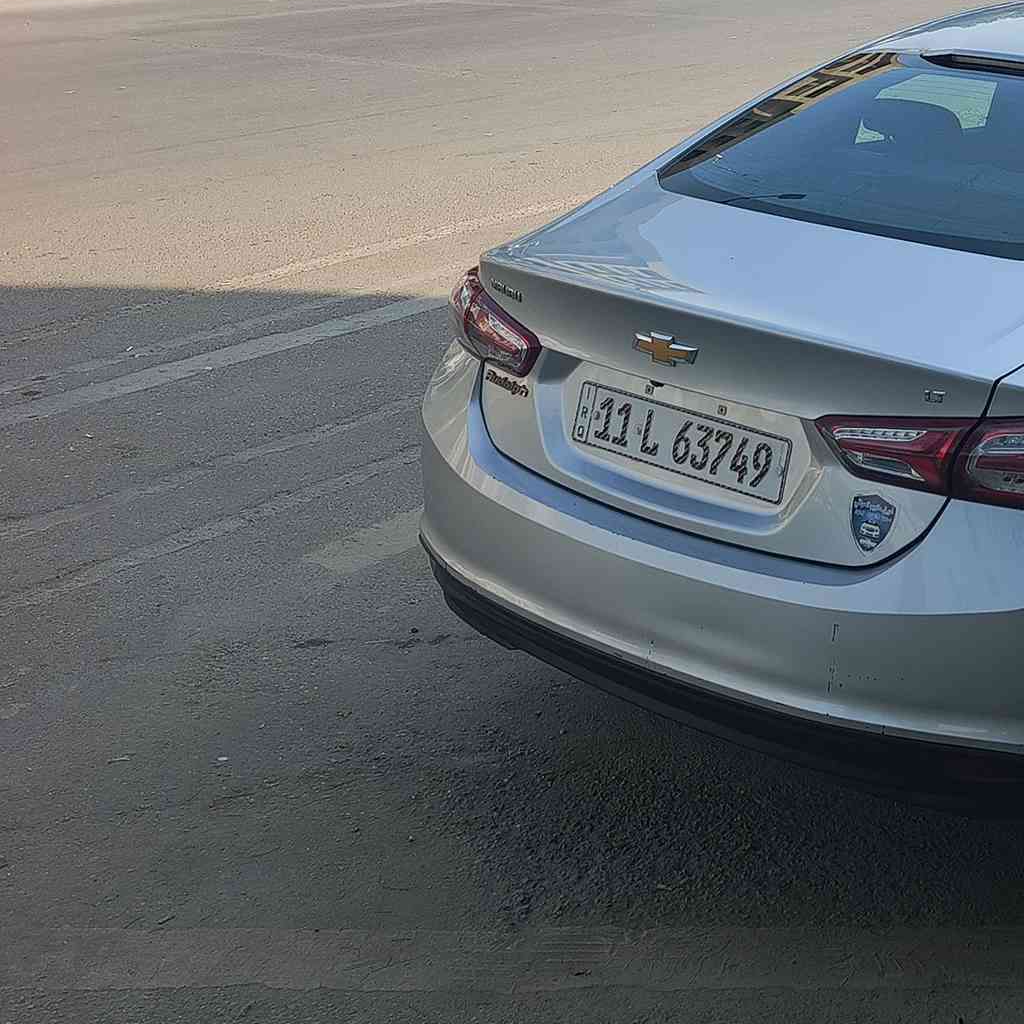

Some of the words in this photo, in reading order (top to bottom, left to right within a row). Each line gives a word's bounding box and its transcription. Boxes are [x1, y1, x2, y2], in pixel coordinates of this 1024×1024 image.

[594, 397, 632, 447] 11
[641, 408, 658, 456] L
[672, 421, 774, 487] 63749
